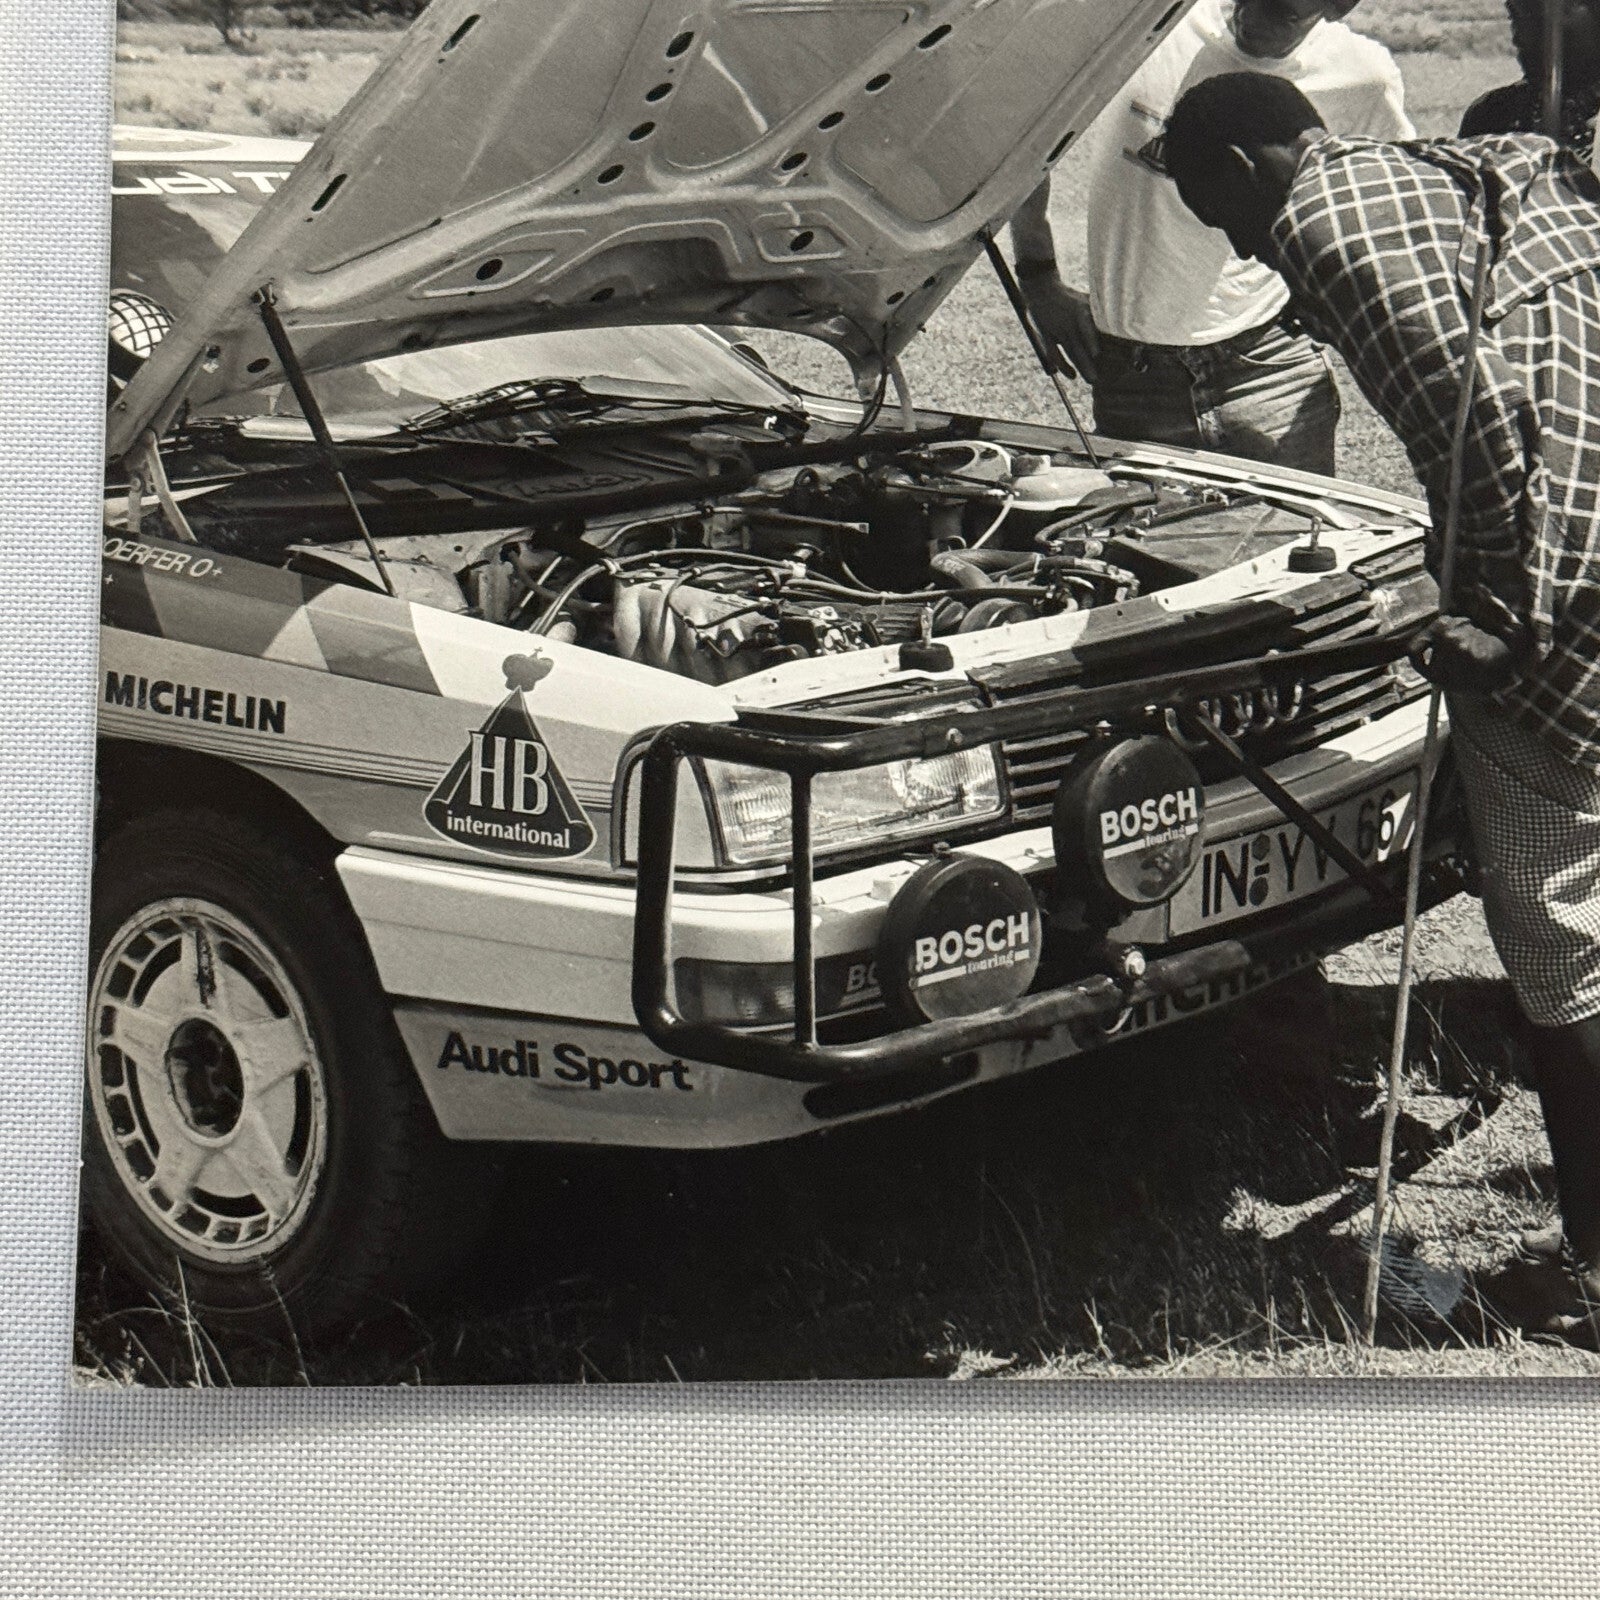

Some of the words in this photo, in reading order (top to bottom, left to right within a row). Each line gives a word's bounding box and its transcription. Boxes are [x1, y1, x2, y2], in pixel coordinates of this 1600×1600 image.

[102, 537, 192, 574] OERFER
[104, 670, 287, 734] MICHELIN
[469, 731, 549, 815] HB
[446, 810, 571, 849] international
[1100, 786, 1198, 844] BOSCH
[916, 911, 1029, 973] BOSCH
[437, 1030, 540, 1079] Audi
[553, 1042, 693, 1091] Sport
